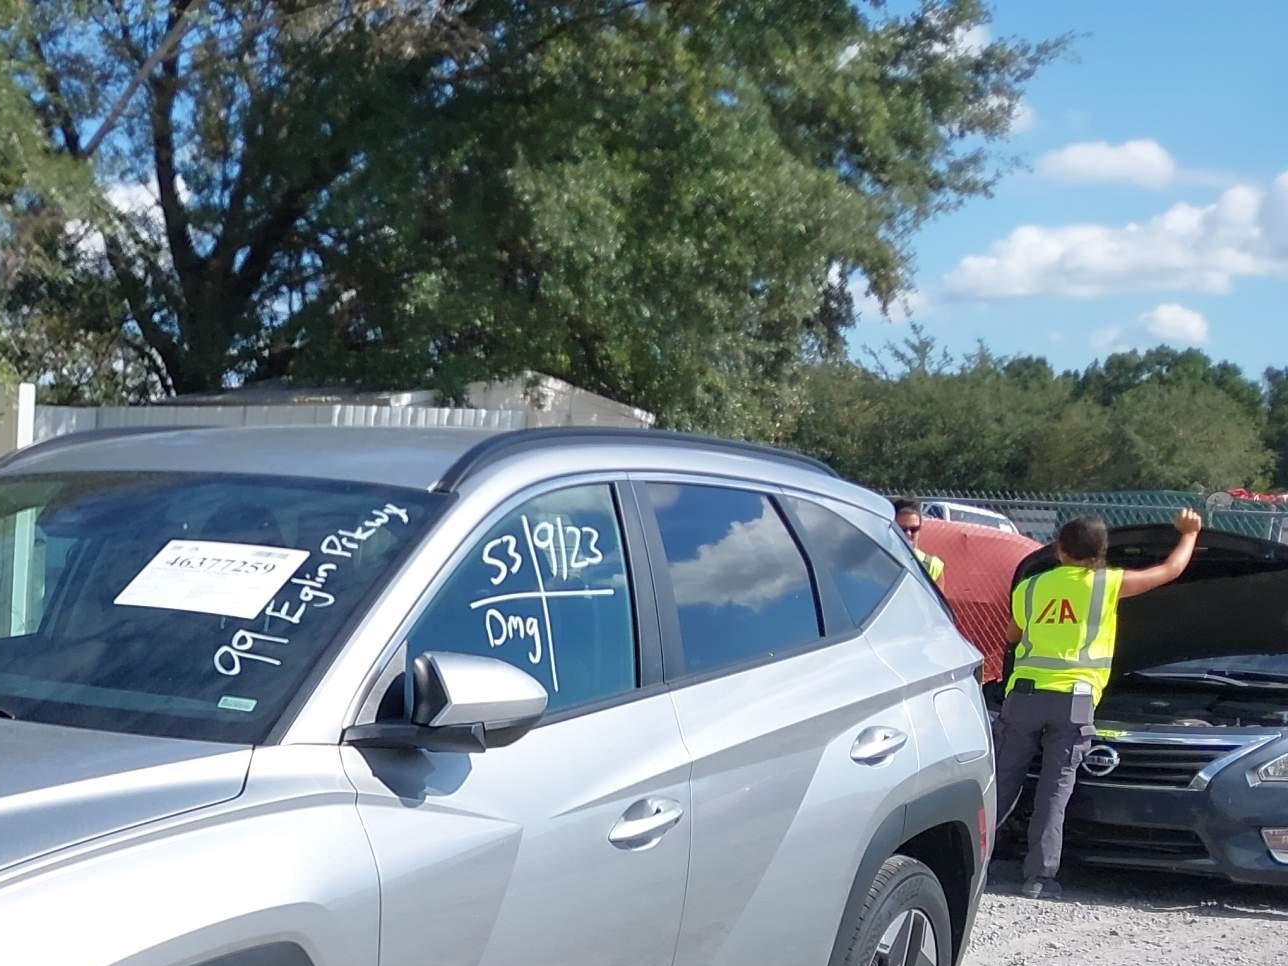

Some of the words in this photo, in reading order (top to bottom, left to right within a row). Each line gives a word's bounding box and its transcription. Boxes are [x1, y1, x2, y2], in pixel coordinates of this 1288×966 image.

[165, 555, 277, 575] 46377259
[264, 562, 337, 624] Eglin
[485, 608, 542, 664] Dmg
